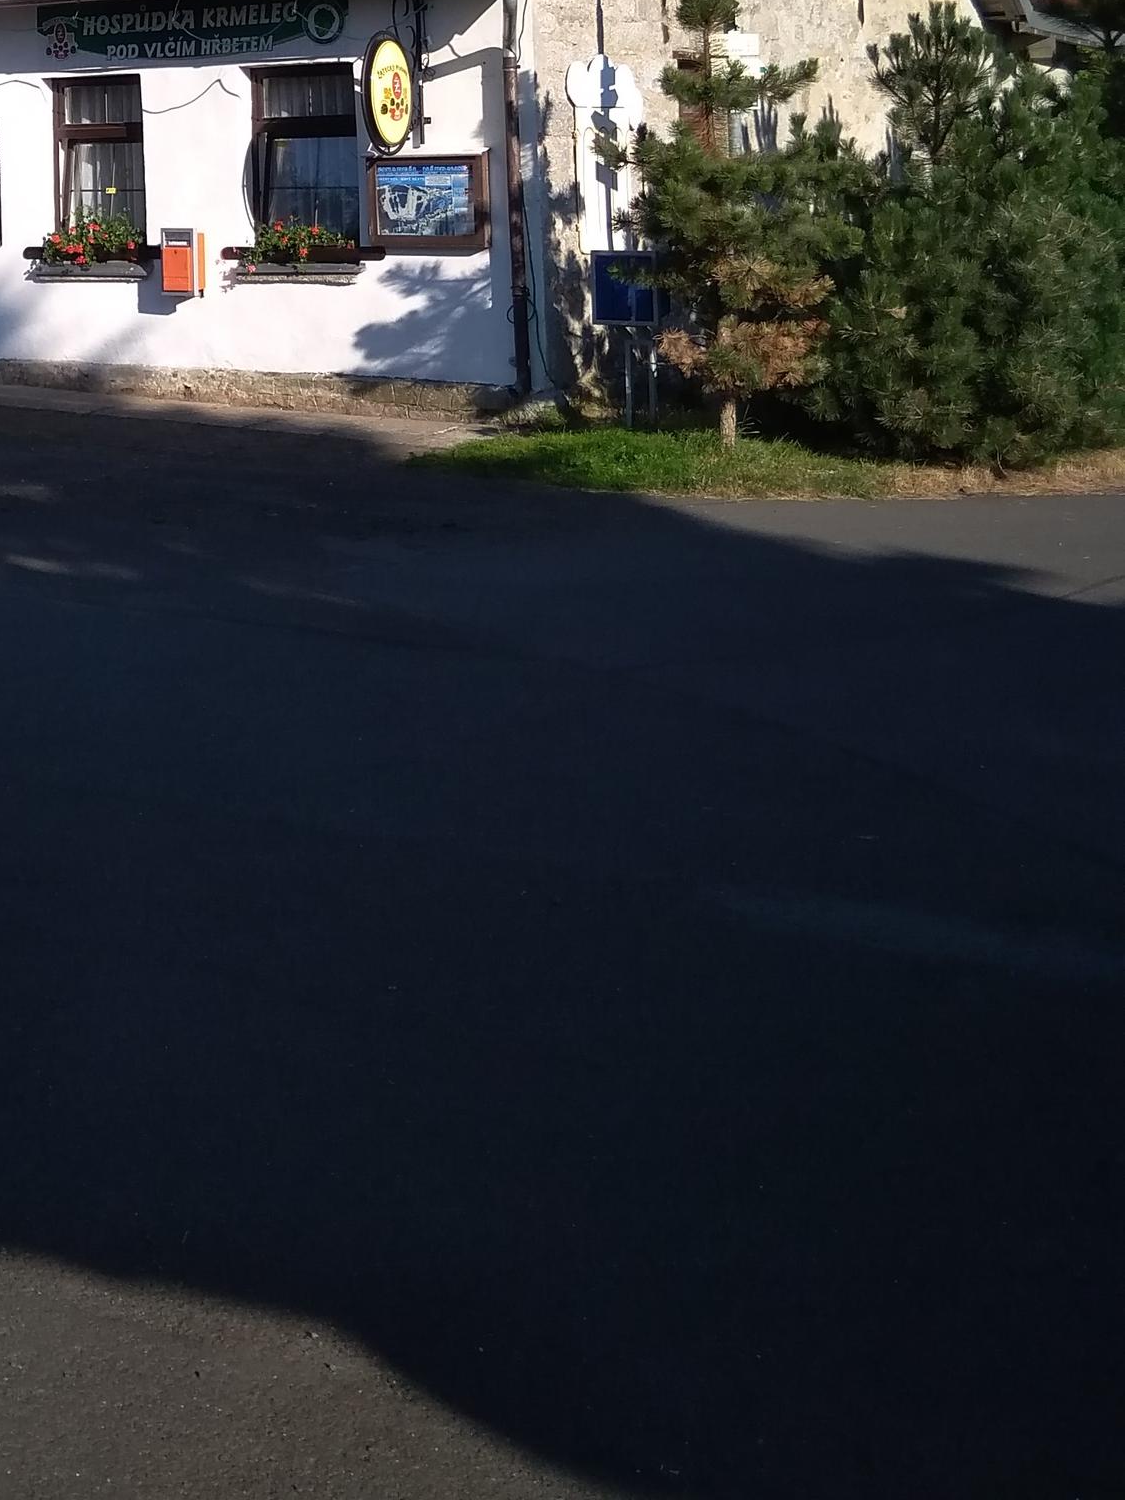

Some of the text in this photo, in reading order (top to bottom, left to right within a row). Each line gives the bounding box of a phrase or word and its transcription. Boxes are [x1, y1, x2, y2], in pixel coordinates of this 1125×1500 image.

[83, 4, 194, 35] HOSPŮDKA
[202, 1, 297, 28] KRMELEC
[107, 33, 273, 60] POD VLČÍM HŘBETEM
